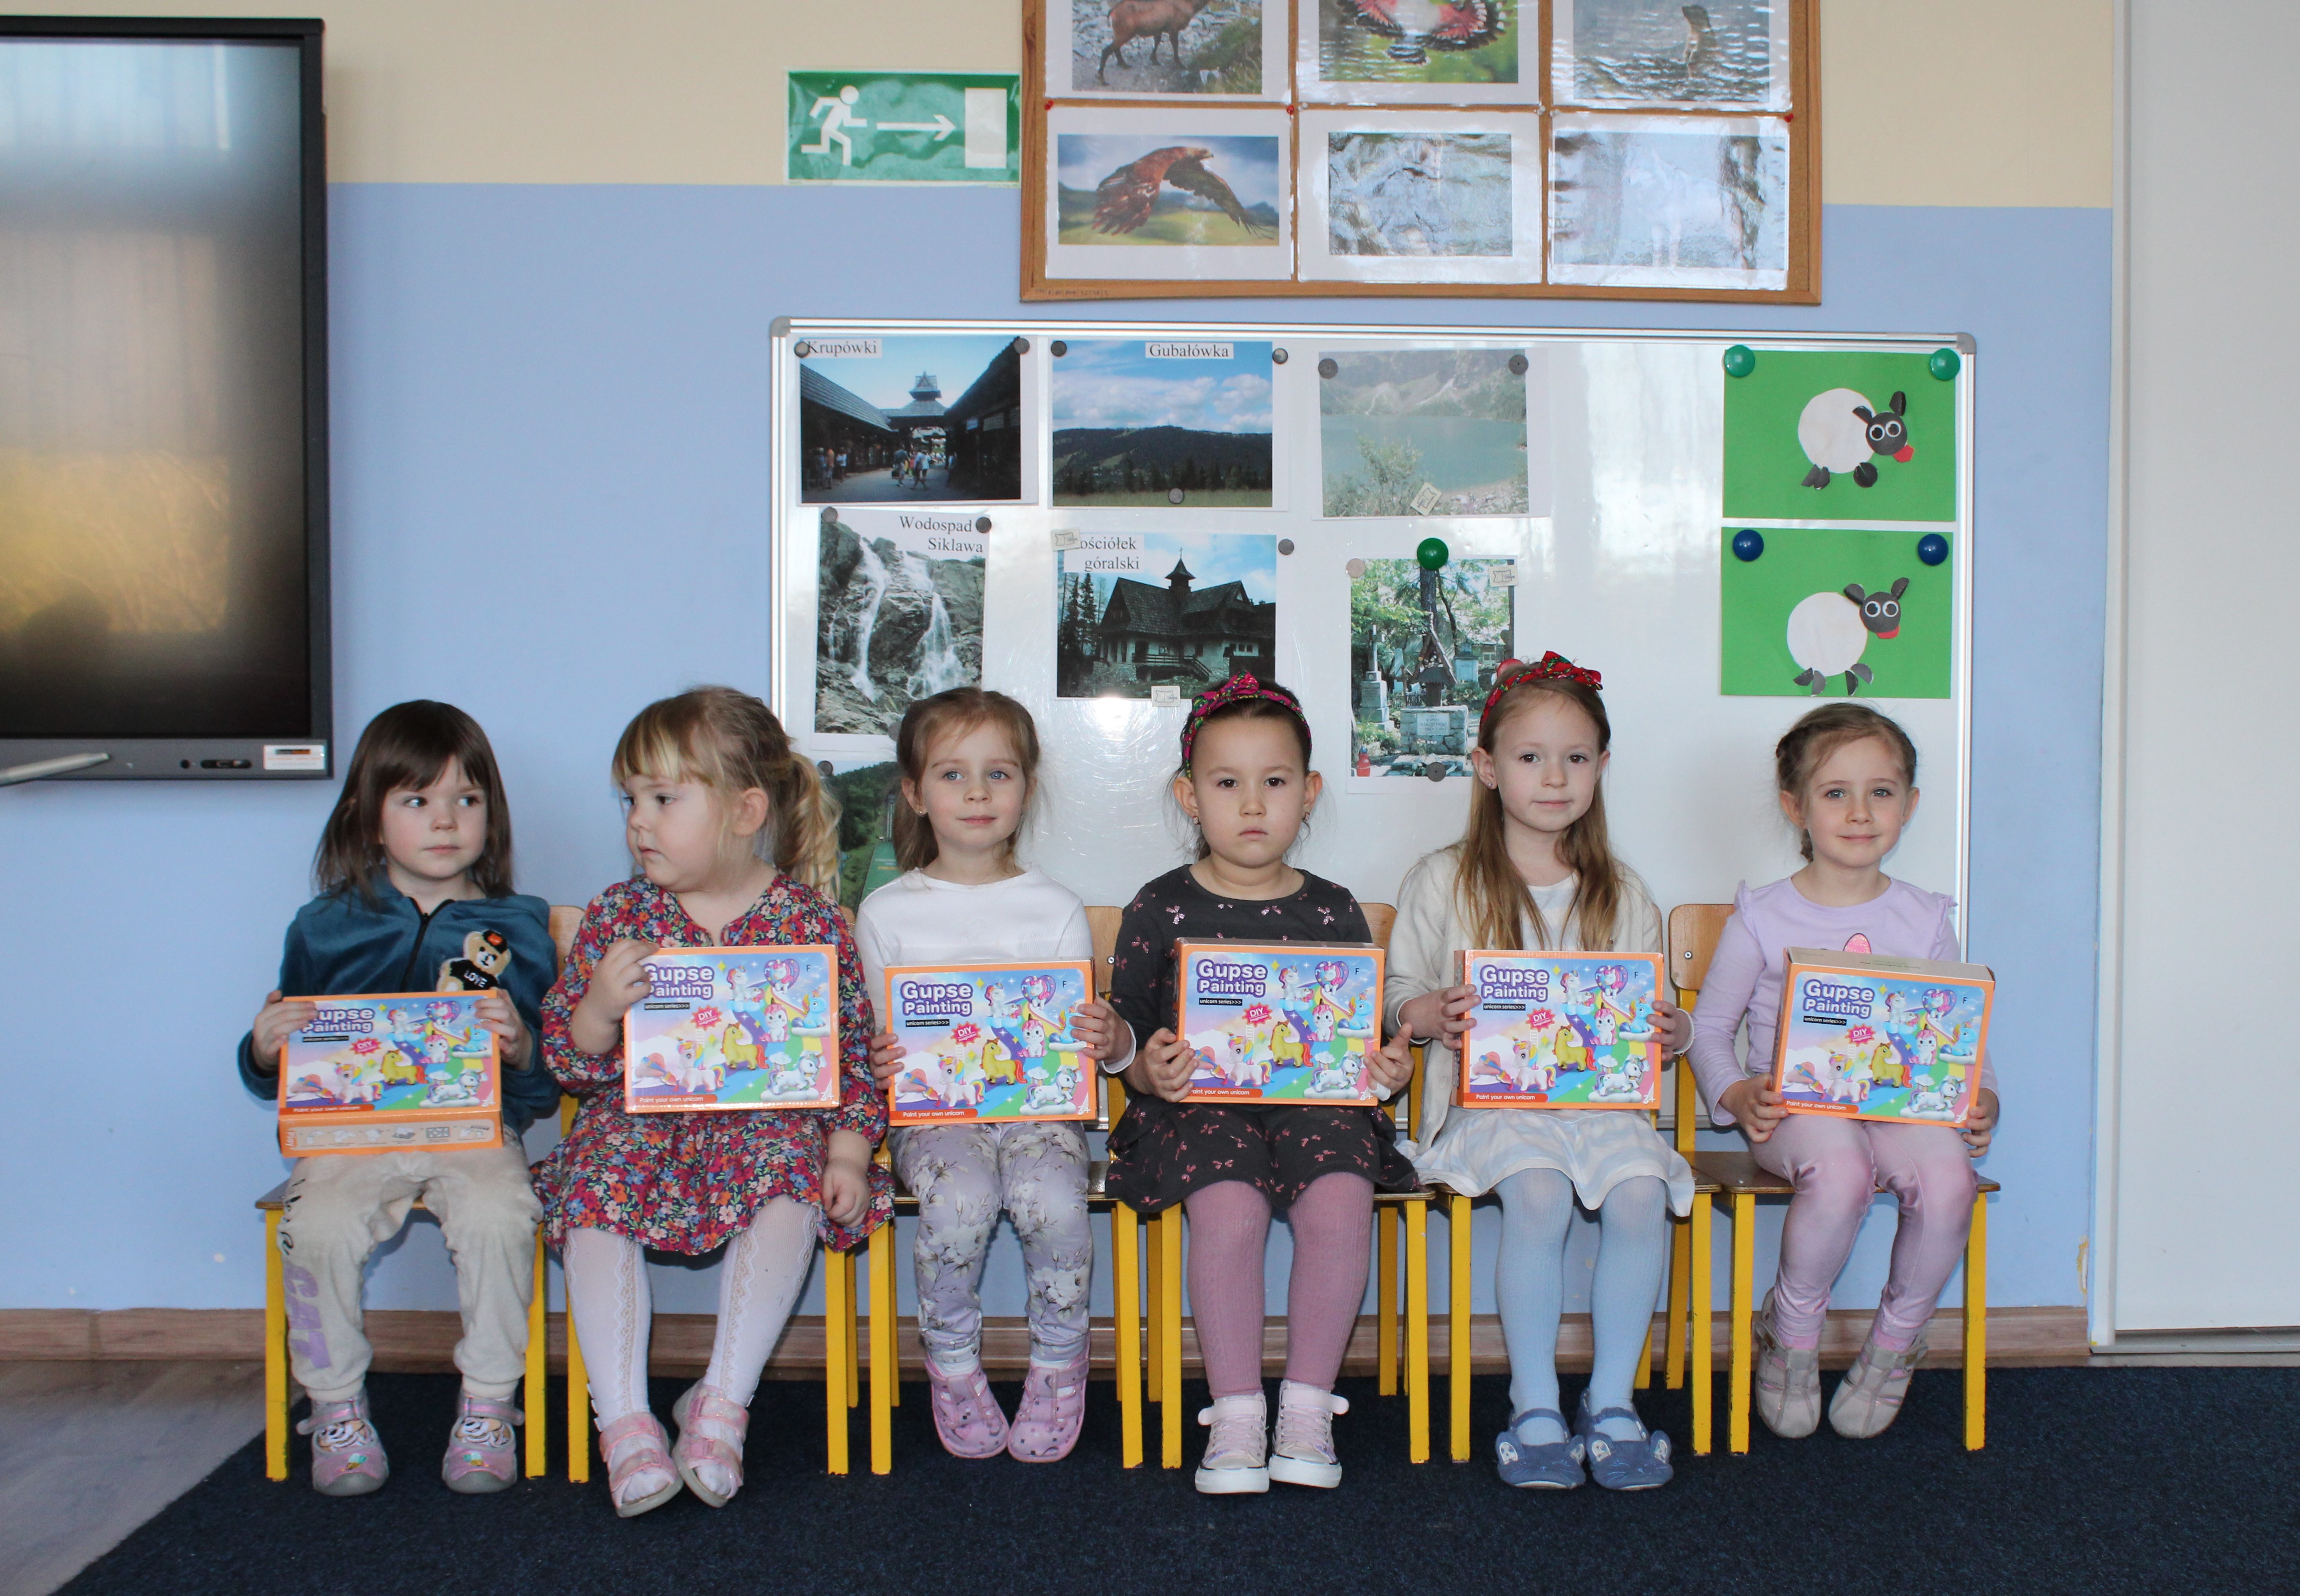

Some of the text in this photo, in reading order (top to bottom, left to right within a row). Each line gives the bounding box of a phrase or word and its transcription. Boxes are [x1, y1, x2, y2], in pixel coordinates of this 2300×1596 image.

[807, 341, 877, 357] Krupówki
[1150, 344, 1229, 357] Gubałówka
[900, 516, 972, 534] Wodospad
[928, 537, 983, 553] Siklawa
[1080, 537, 1137, 550] ościółek
[1085, 557, 1139, 572] góralski
[463, 970, 488, 988] LOVE
[644, 964, 714, 985] Gupse
[1198, 960, 1267, 982] Gupse
[1482, 966, 1549, 987] Gupse
[901, 982, 972, 1002] Gupse
[1199, 979, 1265, 997] Painting
[1482, 985, 1547, 1001] Painting
[1805, 980, 1875, 1002] Gupse
[316, 1008, 374, 1023] upse
[698, 1010, 713, 1021] DIY
[903, 1000, 971, 1015] Painting
[1249, 1007, 1264, 1017] DIY
[1805, 998, 1870, 1018] Painting
[1533, 1012, 1546, 1022] DIY
[958, 1026, 972, 1037] DIY
[1853, 1028, 1867, 1037] DIY
[357, 1041, 373, 1049] DIY
